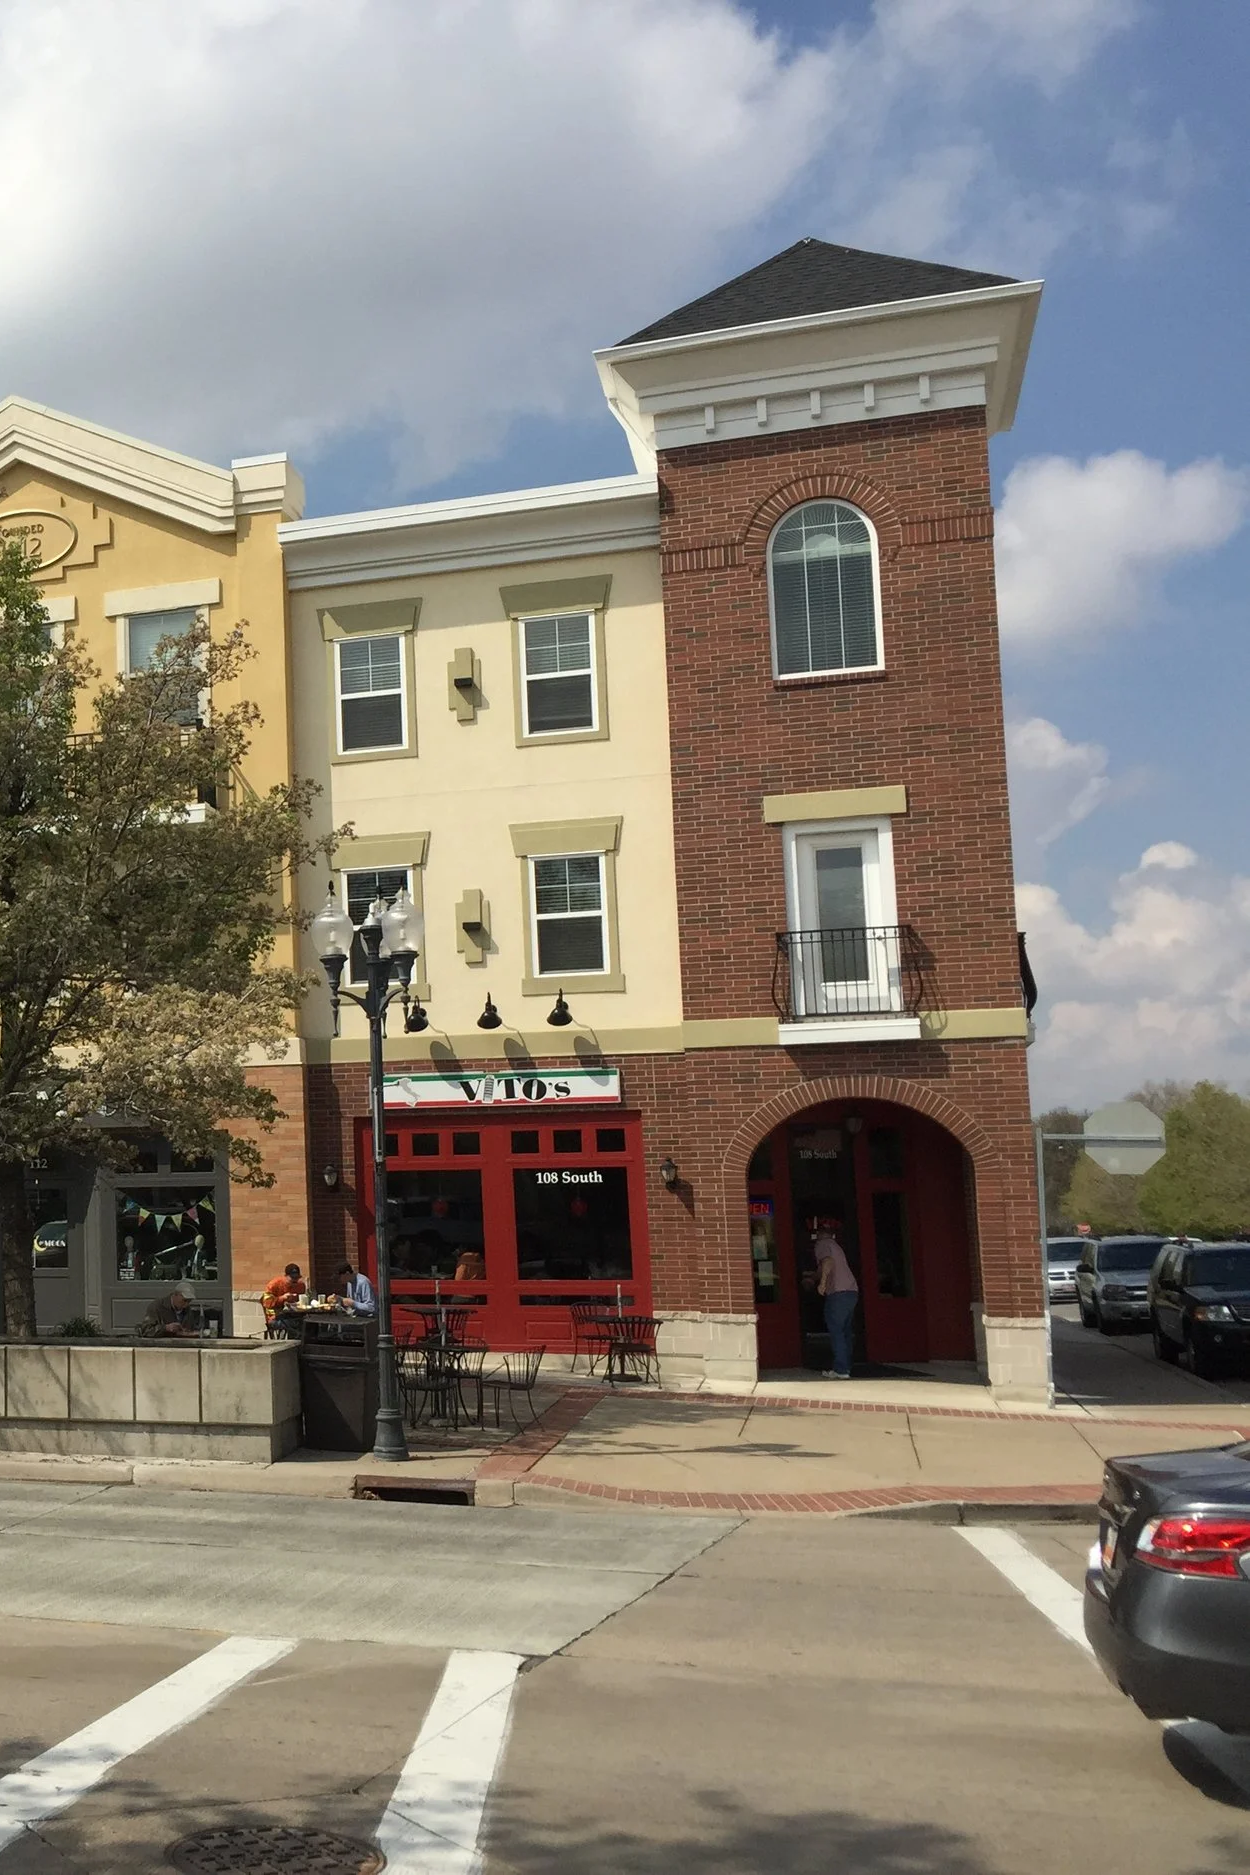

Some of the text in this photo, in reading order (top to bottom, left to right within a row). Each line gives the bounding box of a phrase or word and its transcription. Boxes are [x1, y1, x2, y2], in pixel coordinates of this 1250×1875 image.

[460, 1075, 571, 1104] VITO'S
[535, 1170, 604, 1184] 108 South
[750, 1203, 770, 1215] EN
